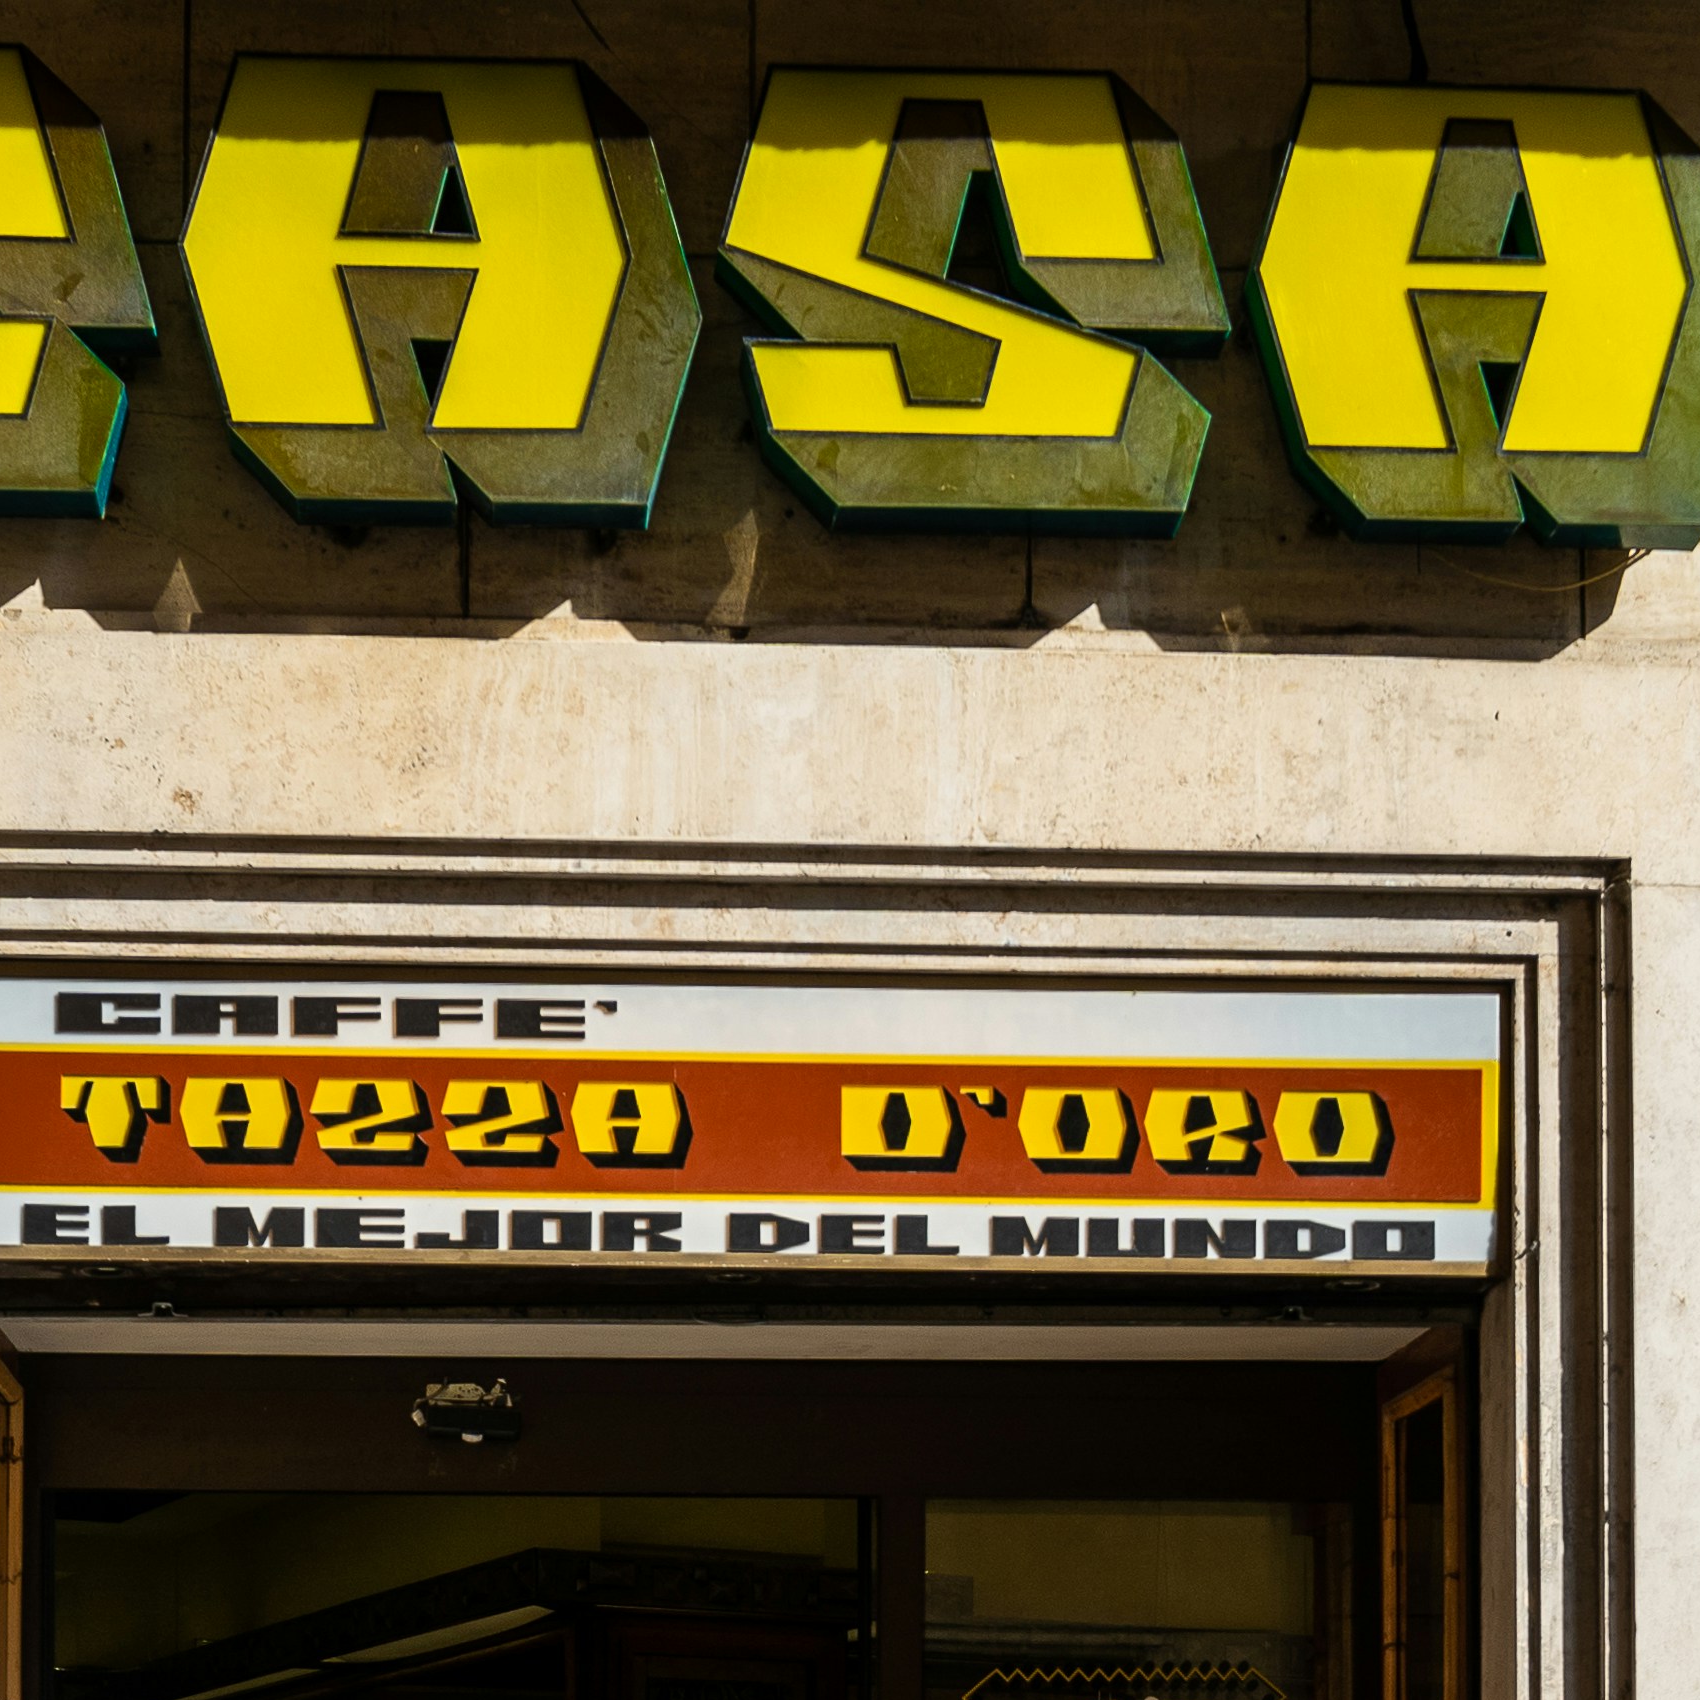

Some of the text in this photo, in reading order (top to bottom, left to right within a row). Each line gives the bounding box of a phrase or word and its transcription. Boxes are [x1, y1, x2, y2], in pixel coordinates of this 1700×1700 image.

[59, 1074, 1396, 1177] TAZZA D'ORO
[20, 1202, 1436, 1261] EL MEJOR DEL MUNDO
